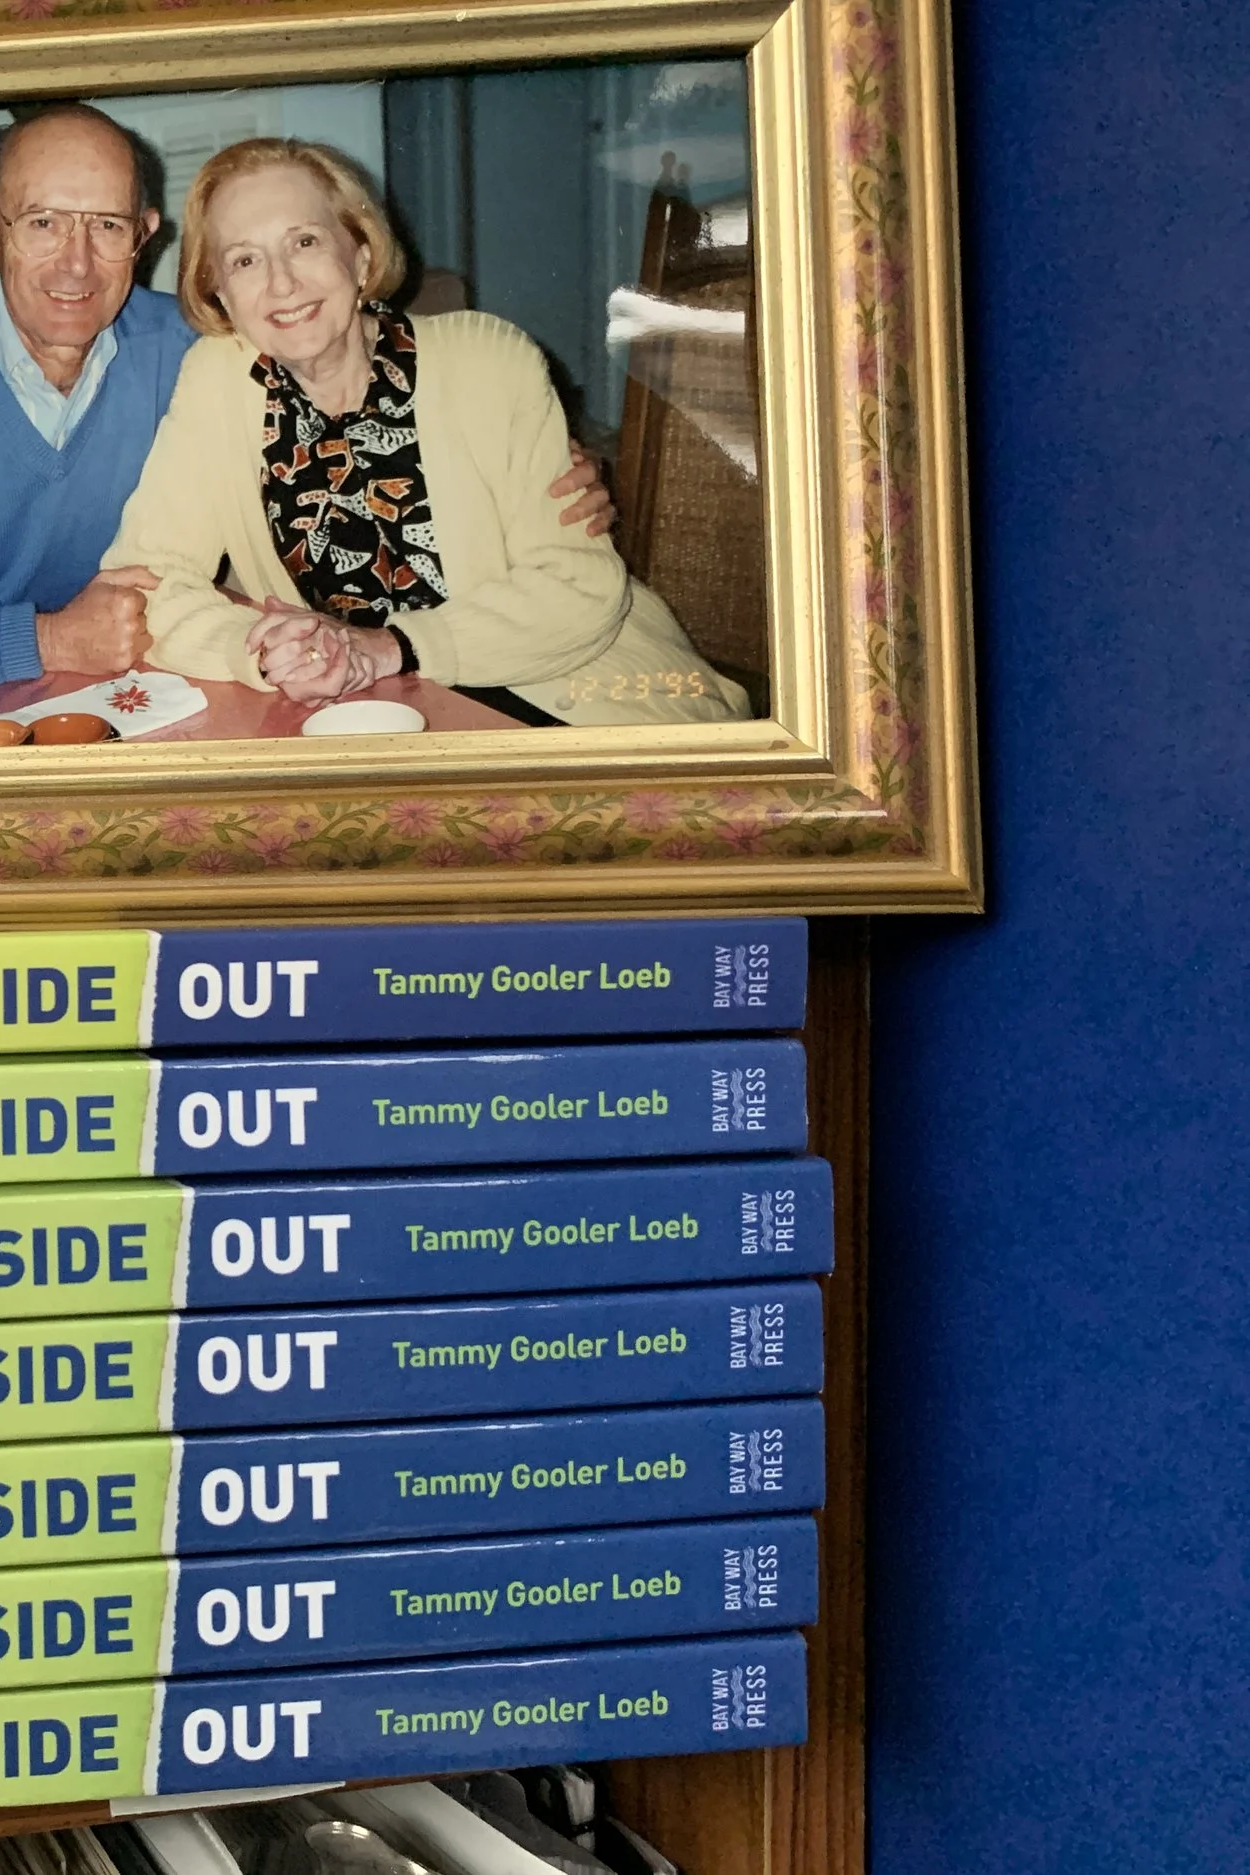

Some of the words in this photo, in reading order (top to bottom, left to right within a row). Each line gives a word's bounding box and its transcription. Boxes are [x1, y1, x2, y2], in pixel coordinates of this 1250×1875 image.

[373, 967, 482, 998] Tammy
[491, 964, 591, 992] Gooler
[599, 962, 671, 990] Loeb
[714, 945, 731, 979] WAY
[748, 943, 770, 1007] PRESS
[179, 960, 318, 1020] OUT
[713, 980, 731, 1008] BAY
[711, 1069, 728, 1102] WAY
[746, 1067, 766, 1131] PRESS
[179, 1087, 317, 1149] OUT
[373, 1099, 482, 1129] Tammy
[490, 1094, 588, 1121] Gooler
[598, 1090, 669, 1118] Loeb
[712, 1105, 729, 1132] BAY
[741, 1192, 758, 1225] WAY
[775, 1189, 796, 1252] PRESS
[211, 1213, 350, 1277] OUT
[406, 1225, 514, 1254] Tammy
[523, 1217, 620, 1247] Gooler
[630, 1213, 698, 1242] Loeb
[741, 1228, 758, 1256] BAY
[730, 1306, 747, 1339] WAY
[764, 1303, 784, 1366] PRESS
[198, 1331, 338, 1395] OUT
[392, 1341, 501, 1370] Tammy
[510, 1333, 608, 1362] Gooler
[617, 1327, 687, 1357] Loeb
[730, 1341, 747, 1369] BAY
[730, 1432, 746, 1465] WAY
[763, 1428, 783, 1491] PRESS
[201, 1461, 340, 1526] OUT
[394, 1470, 502, 1499] Tammy
[511, 1462, 608, 1491] Gooler
[617, 1454, 687, 1484] Loeb
[730, 1467, 746, 1494] BAY
[724, 1548, 741, 1581] WAY
[758, 1544, 778, 1607] PRESS
[197, 1580, 336, 1646] OUT
[390, 1589, 498, 1617] Tammy
[506, 1580, 603, 1608] Gooler
[612, 1570, 681, 1600] Loeb
[724, 1583, 741, 1610] BAY
[712, 1668, 729, 1702] WAY
[746, 1665, 766, 1727] PRESS
[183, 1700, 321, 1764] OUT
[376, 1708, 484, 1736] Tammy
[492, 1700, 589, 1728] Gooler
[599, 1691, 669, 1719] Loeb
[712, 1704, 729, 1731] BAY
